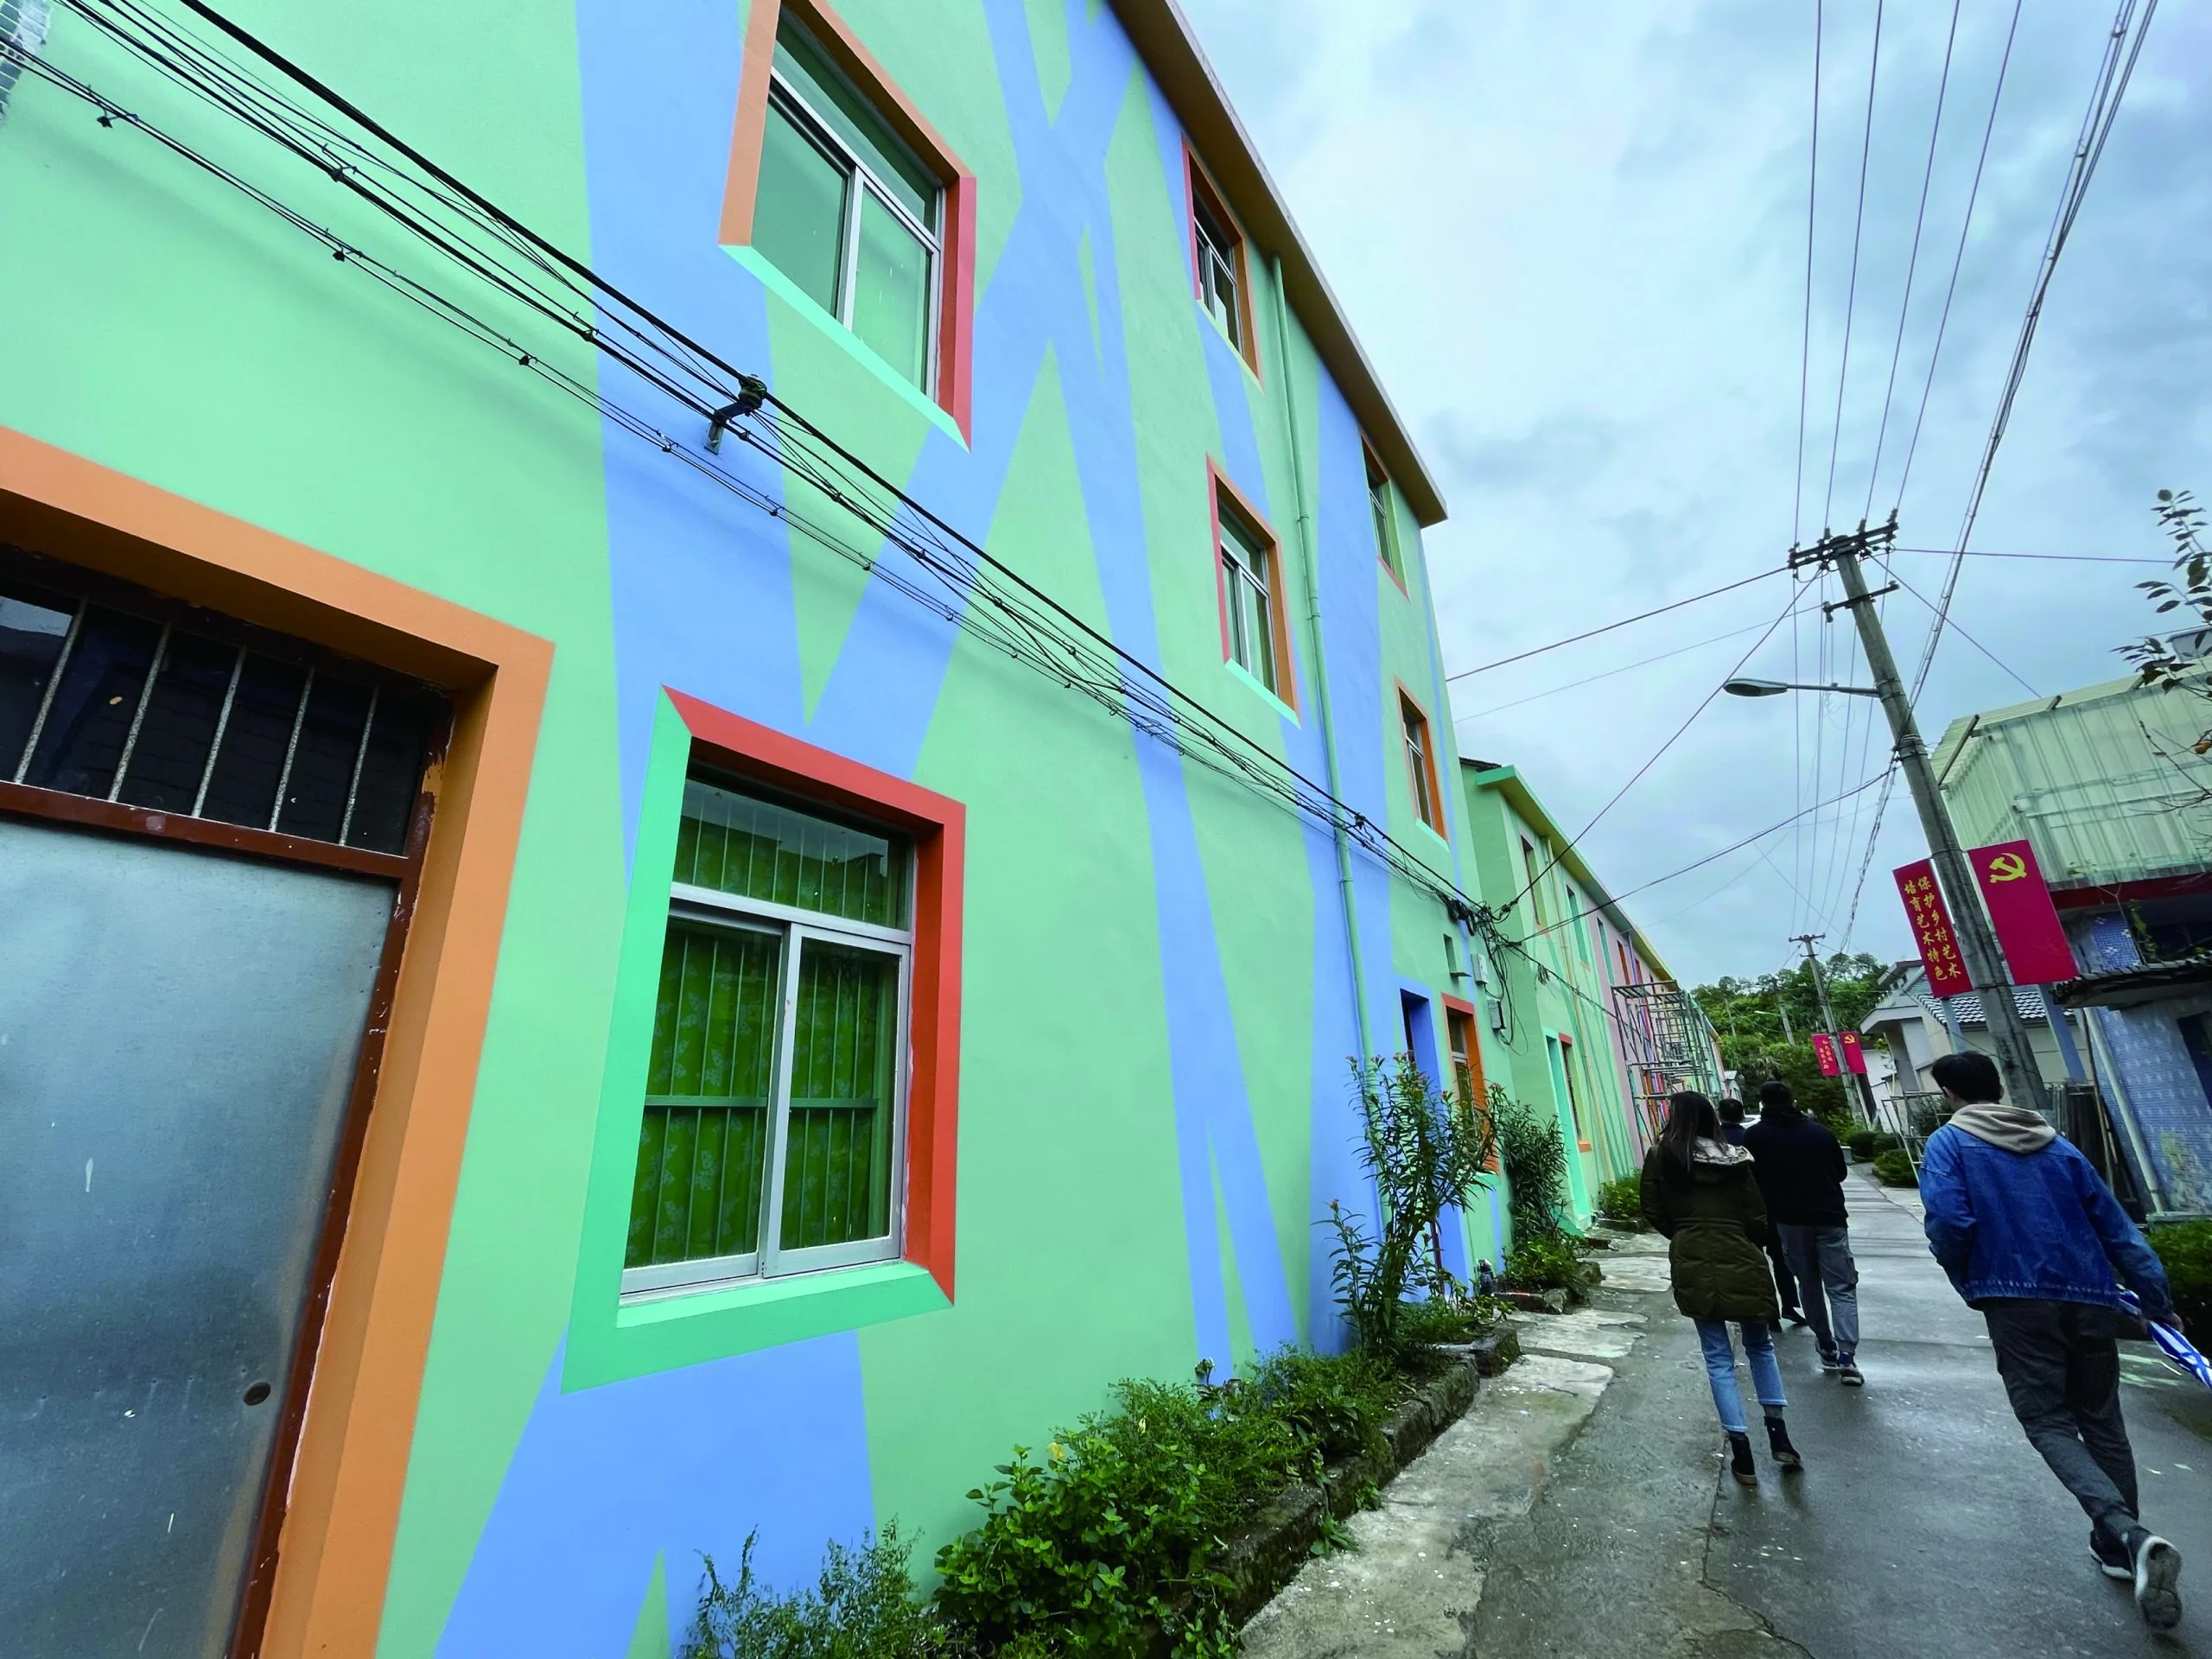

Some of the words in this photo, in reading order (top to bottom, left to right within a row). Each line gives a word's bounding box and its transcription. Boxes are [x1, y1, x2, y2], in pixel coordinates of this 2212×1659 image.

[1904, 880, 1948, 981] 培育艺术特色
[1917, 876, 1961, 979] 保护乡村艺术
